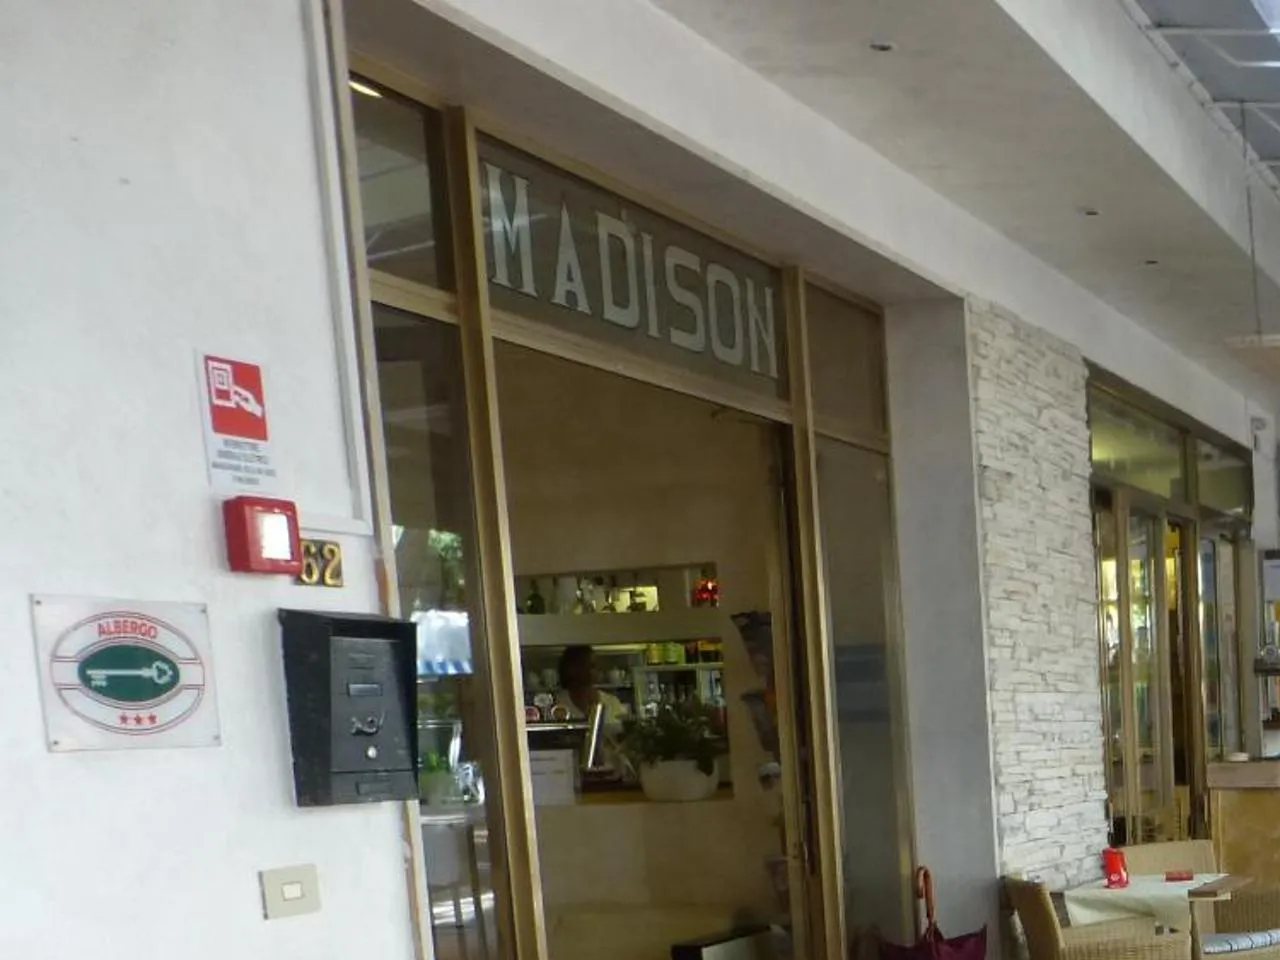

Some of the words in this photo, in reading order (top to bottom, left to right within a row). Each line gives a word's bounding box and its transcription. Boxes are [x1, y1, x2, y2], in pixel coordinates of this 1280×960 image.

[484, 161, 778, 379] MADISON
[300, 541, 342, 585] 62
[98, 620, 157, 638] ALBERGO
